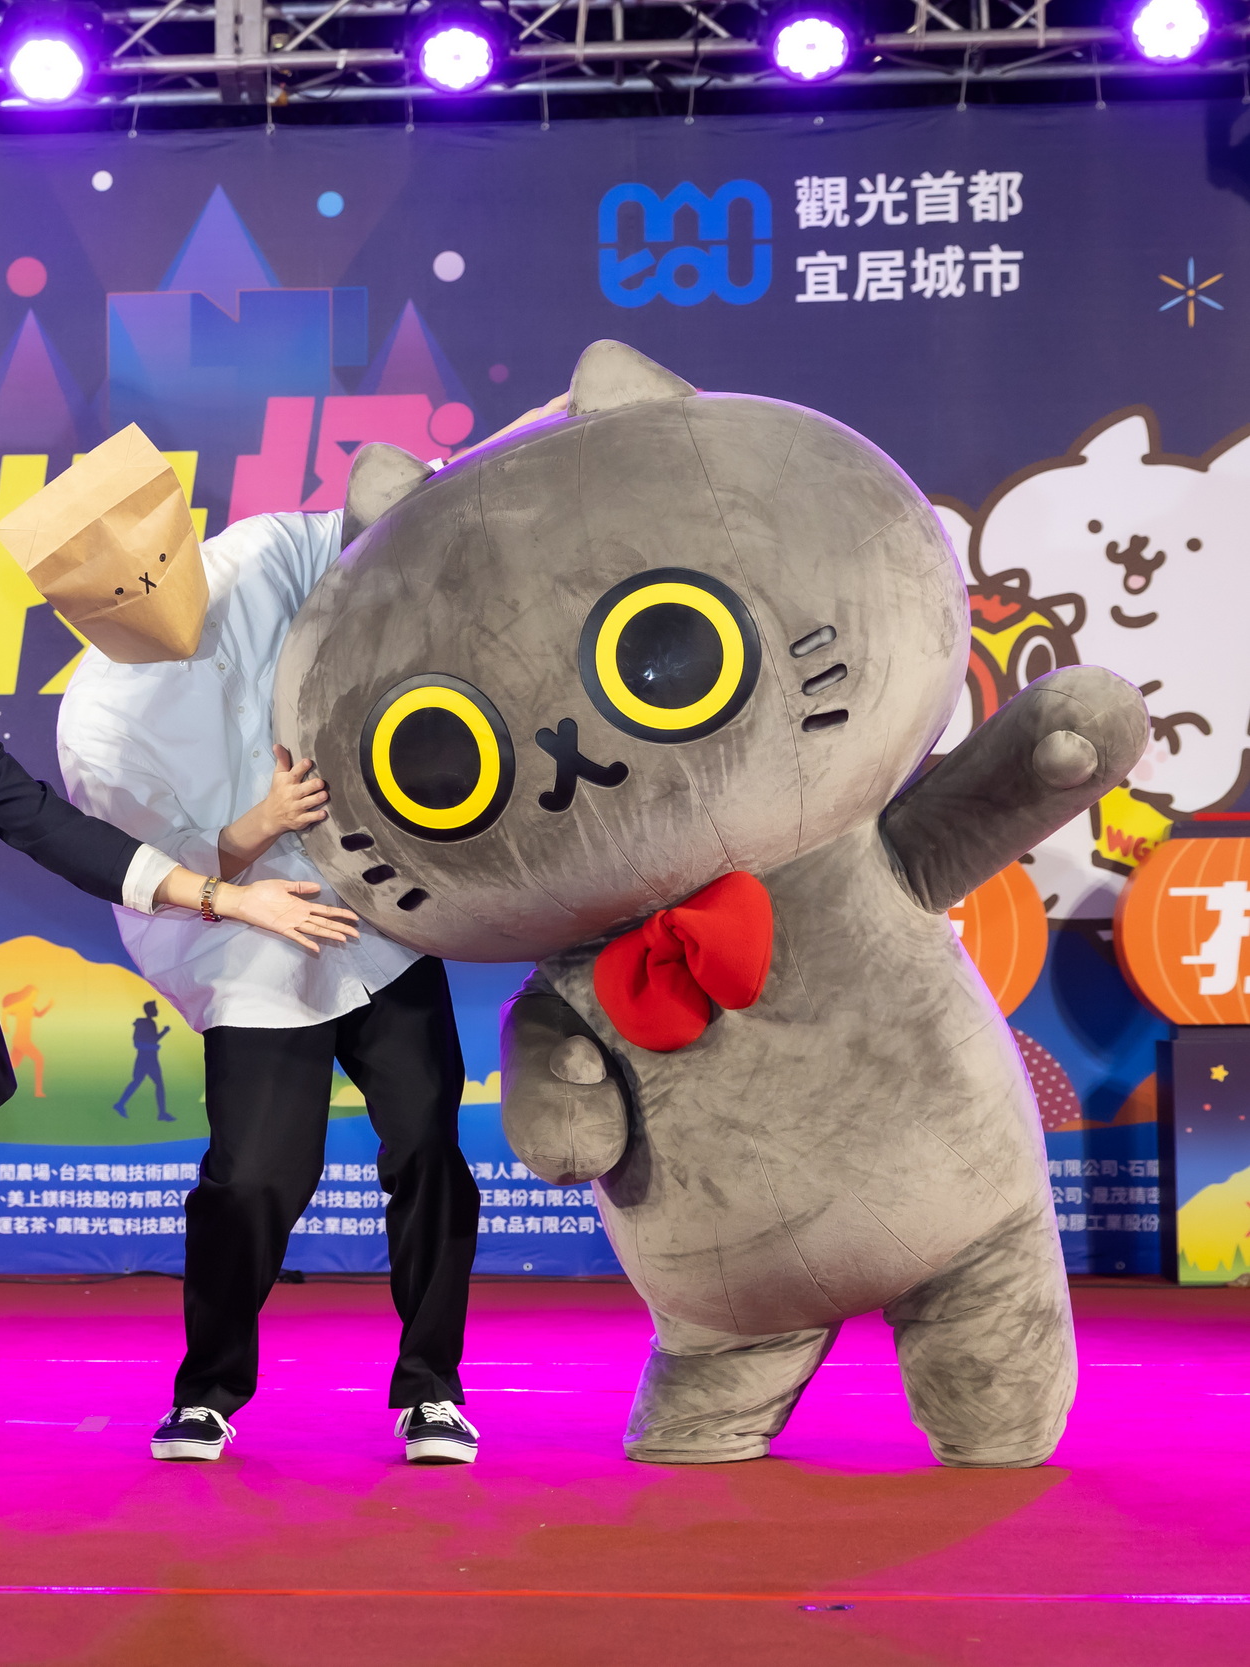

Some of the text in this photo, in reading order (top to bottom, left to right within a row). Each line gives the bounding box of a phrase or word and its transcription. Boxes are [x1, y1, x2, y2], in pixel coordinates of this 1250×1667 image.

[796, 170, 1023, 229] 觀光首都
[796, 245, 1024, 304] 宜居城市
